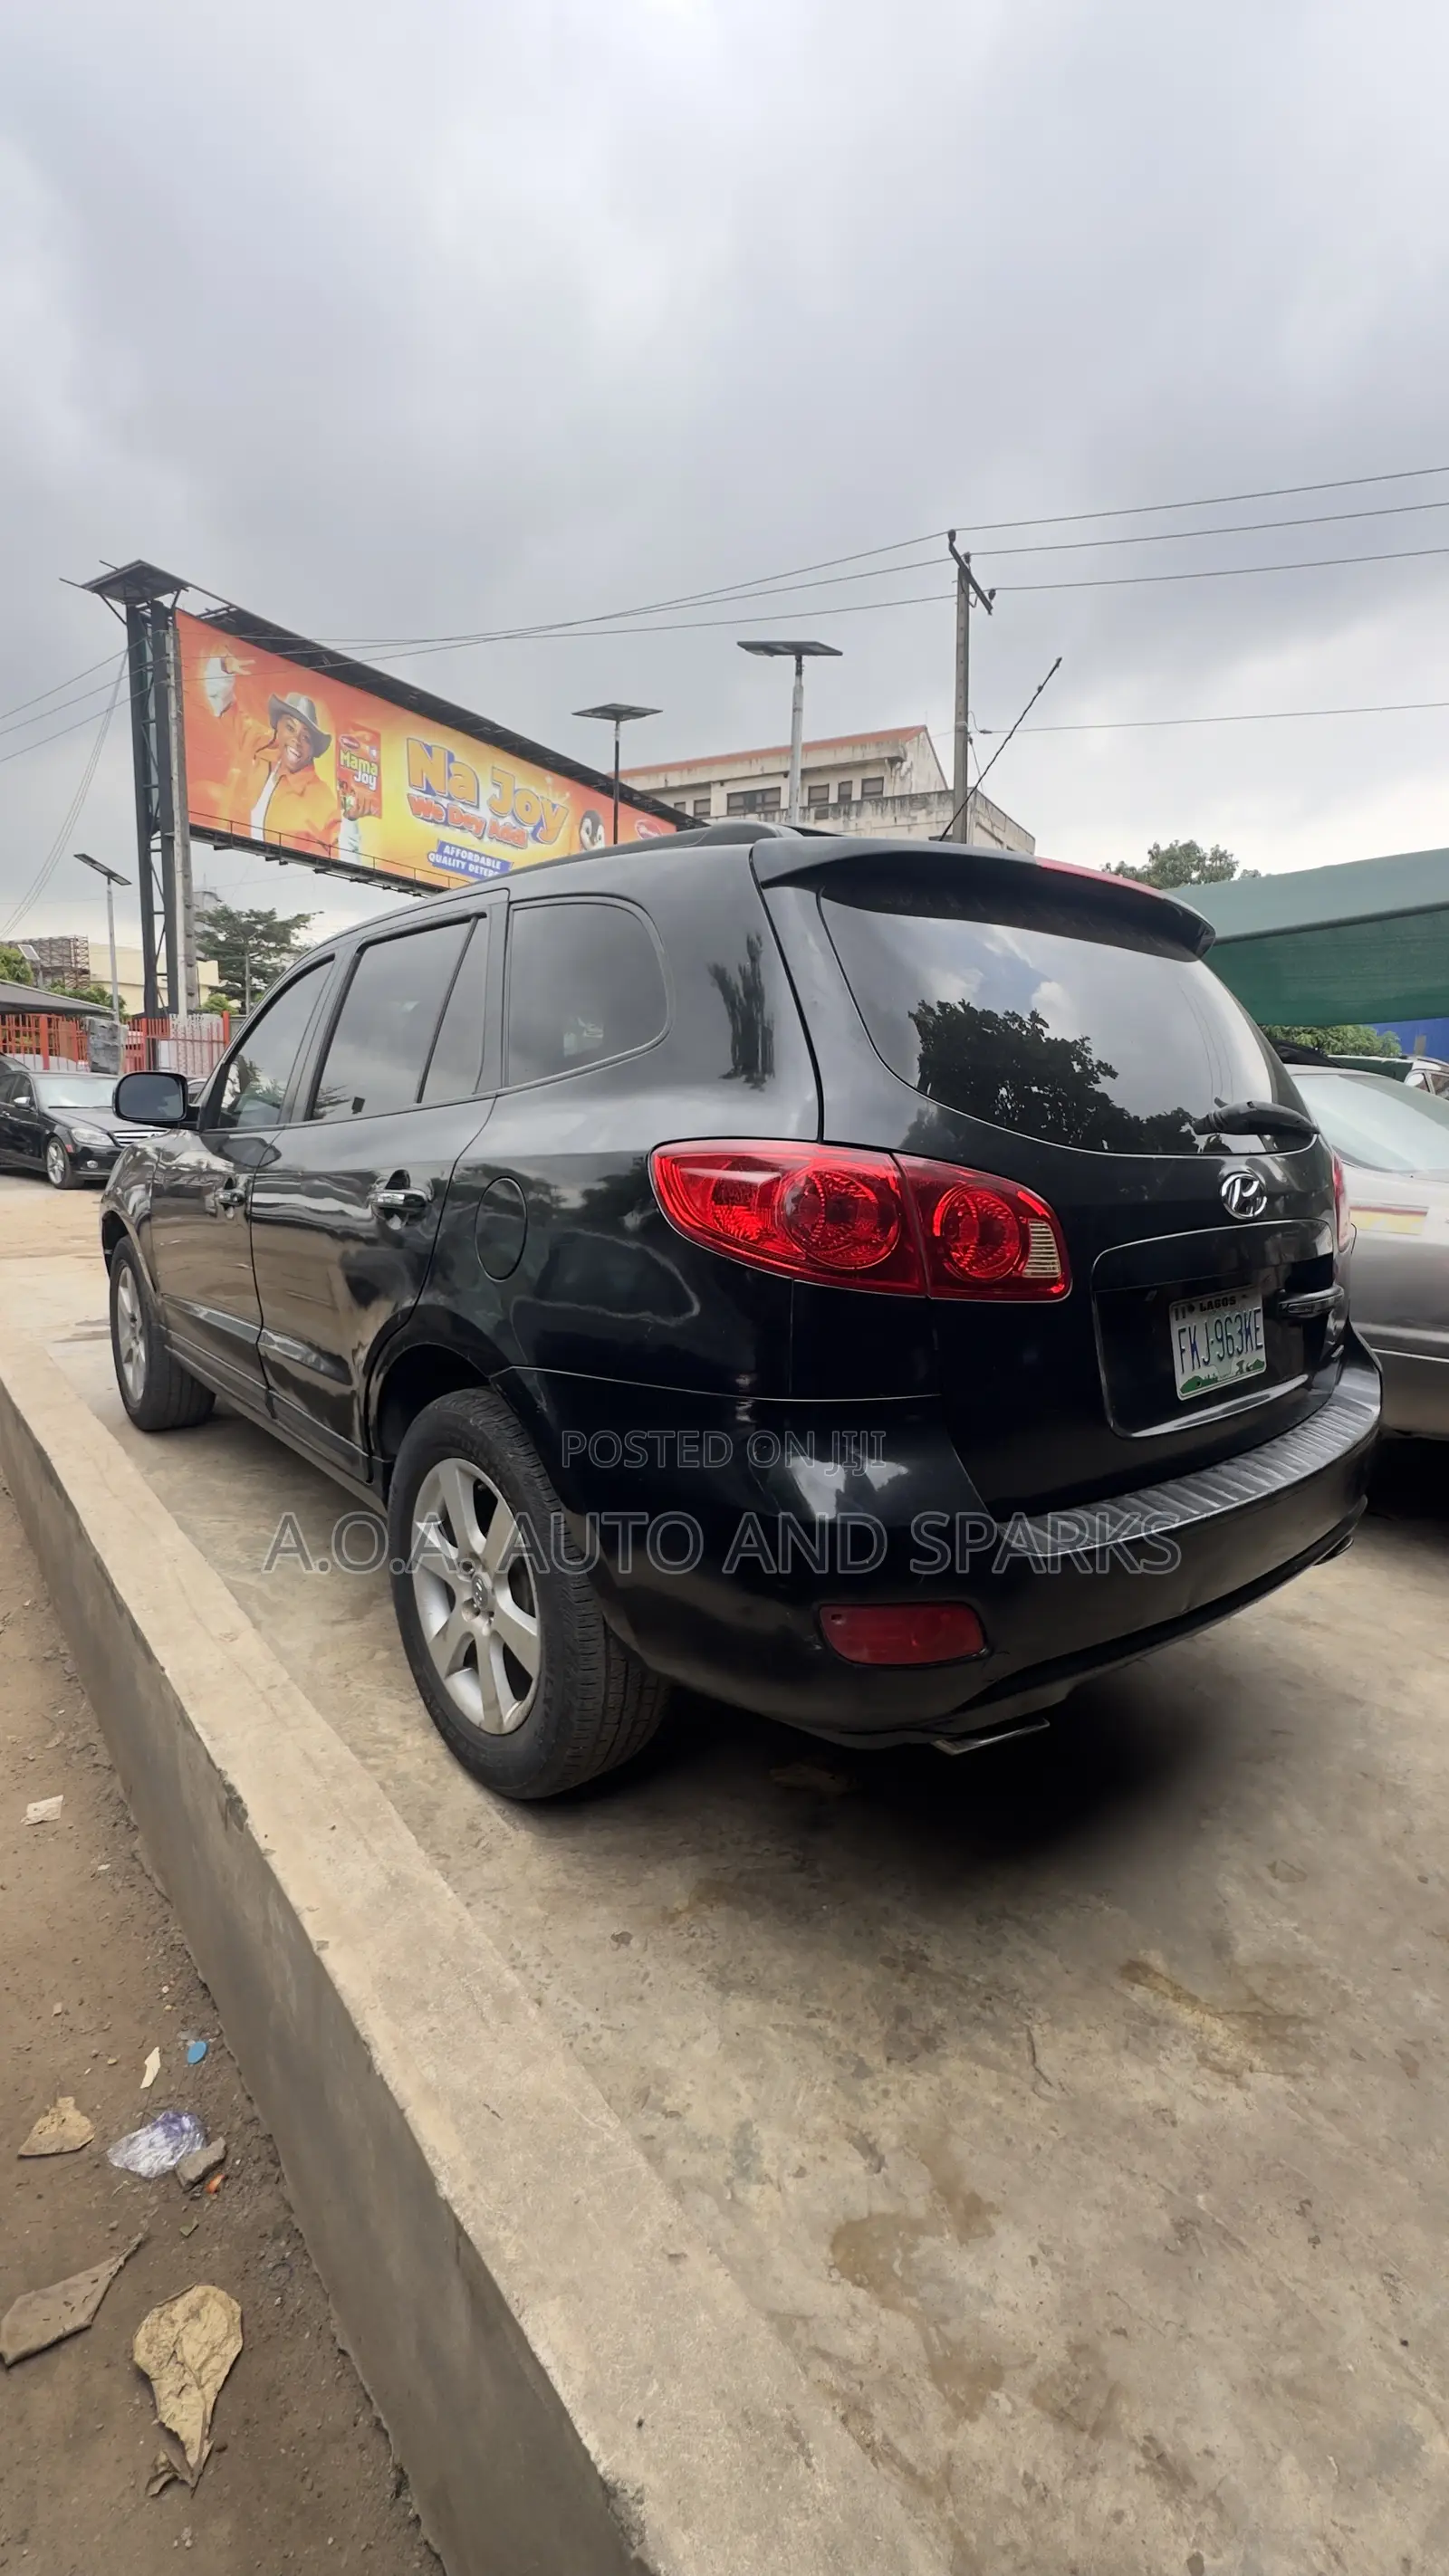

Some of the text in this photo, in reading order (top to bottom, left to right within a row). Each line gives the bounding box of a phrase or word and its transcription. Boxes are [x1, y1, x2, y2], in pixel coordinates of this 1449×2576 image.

[340, 749, 378, 777] Mama
[354, 770, 377, 790] Joy
[407, 738, 569, 845] Na Joy
[408, 794, 446, 823] We
[428, 852, 466, 870] QUALITY
[444, 845, 501, 869] AFFORDABLE
[1199, 1295, 1237, 1312] LAGOS
